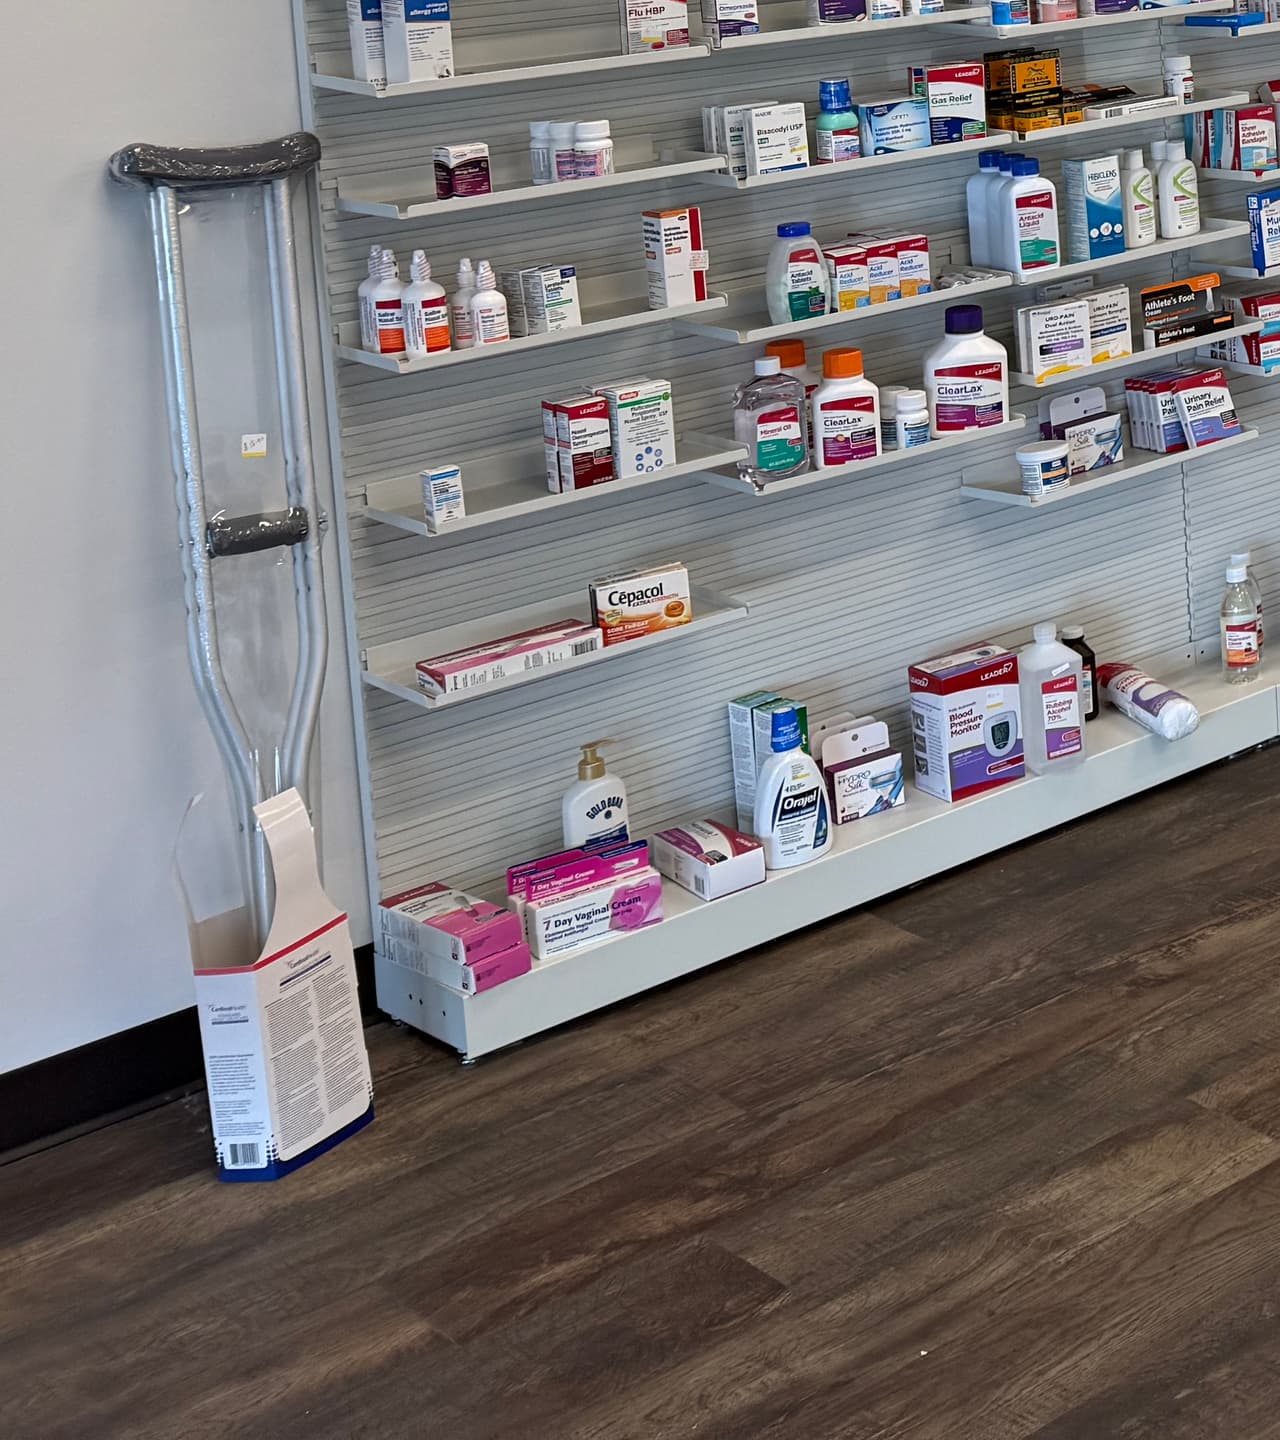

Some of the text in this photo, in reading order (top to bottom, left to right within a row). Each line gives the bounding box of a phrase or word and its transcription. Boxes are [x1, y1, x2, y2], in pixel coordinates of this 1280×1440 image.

[409, 8, 431, 16] allergy
[628, 6, 665, 17] Flu HBP
[931, 93, 972, 105] Gas Relief
[757, 123, 804, 136] Bisacodyl USP
[1241, 125, 1257, 133] Sheer
[1242, 130, 1266, 139] Adhesive
[1242, 136, 1268, 145] Bandages
[1088, 169, 1117, 182] HIBICLENS
[1018, 213, 1044, 223] Antacid
[1019, 220, 1040, 228] Liquid
[899, 258, 914, 266] Acid
[869, 264, 883, 273] Acid
[900, 263, 924, 273] Reducer
[790, 270, 813, 278] Antacid
[839, 272, 853, 280] Acid
[869, 270, 894, 279] Reducer
[839, 276, 864, 285] Reducer
[1145, 293, 1195, 312] Athlete's Foot
[1045, 313, 1075, 322] URO-PAIN
[1159, 324, 1196, 340] Athlete's Foot
[975, 366, 998, 377] LEADER
[937, 384, 983, 395] ClearLax
[1183, 391, 1211, 405] Urinary
[1186, 395, 1225, 413] Pain Relief
[823, 417, 863, 426] ClearLax
[572, 429, 609, 440] Decongestant
[760, 424, 792, 436] Mineral Oil
[1068, 427, 1096, 440] HYDRO
[980, 664, 1013, 681] LEADER
[1046, 699, 1072, 711] Rubbing
[949, 709, 974, 722] Blood
[1046, 706, 1072, 717] Alcohol
[950, 713, 984, 730] Pressure
[1047, 714, 1062, 723] 70%
[950, 722, 982, 738] Monitor
[838, 770, 871, 786] HYDRO
[783, 794, 817, 811] Orajel
[543, 895, 641, 931] 7 Day Vaginal Cream
